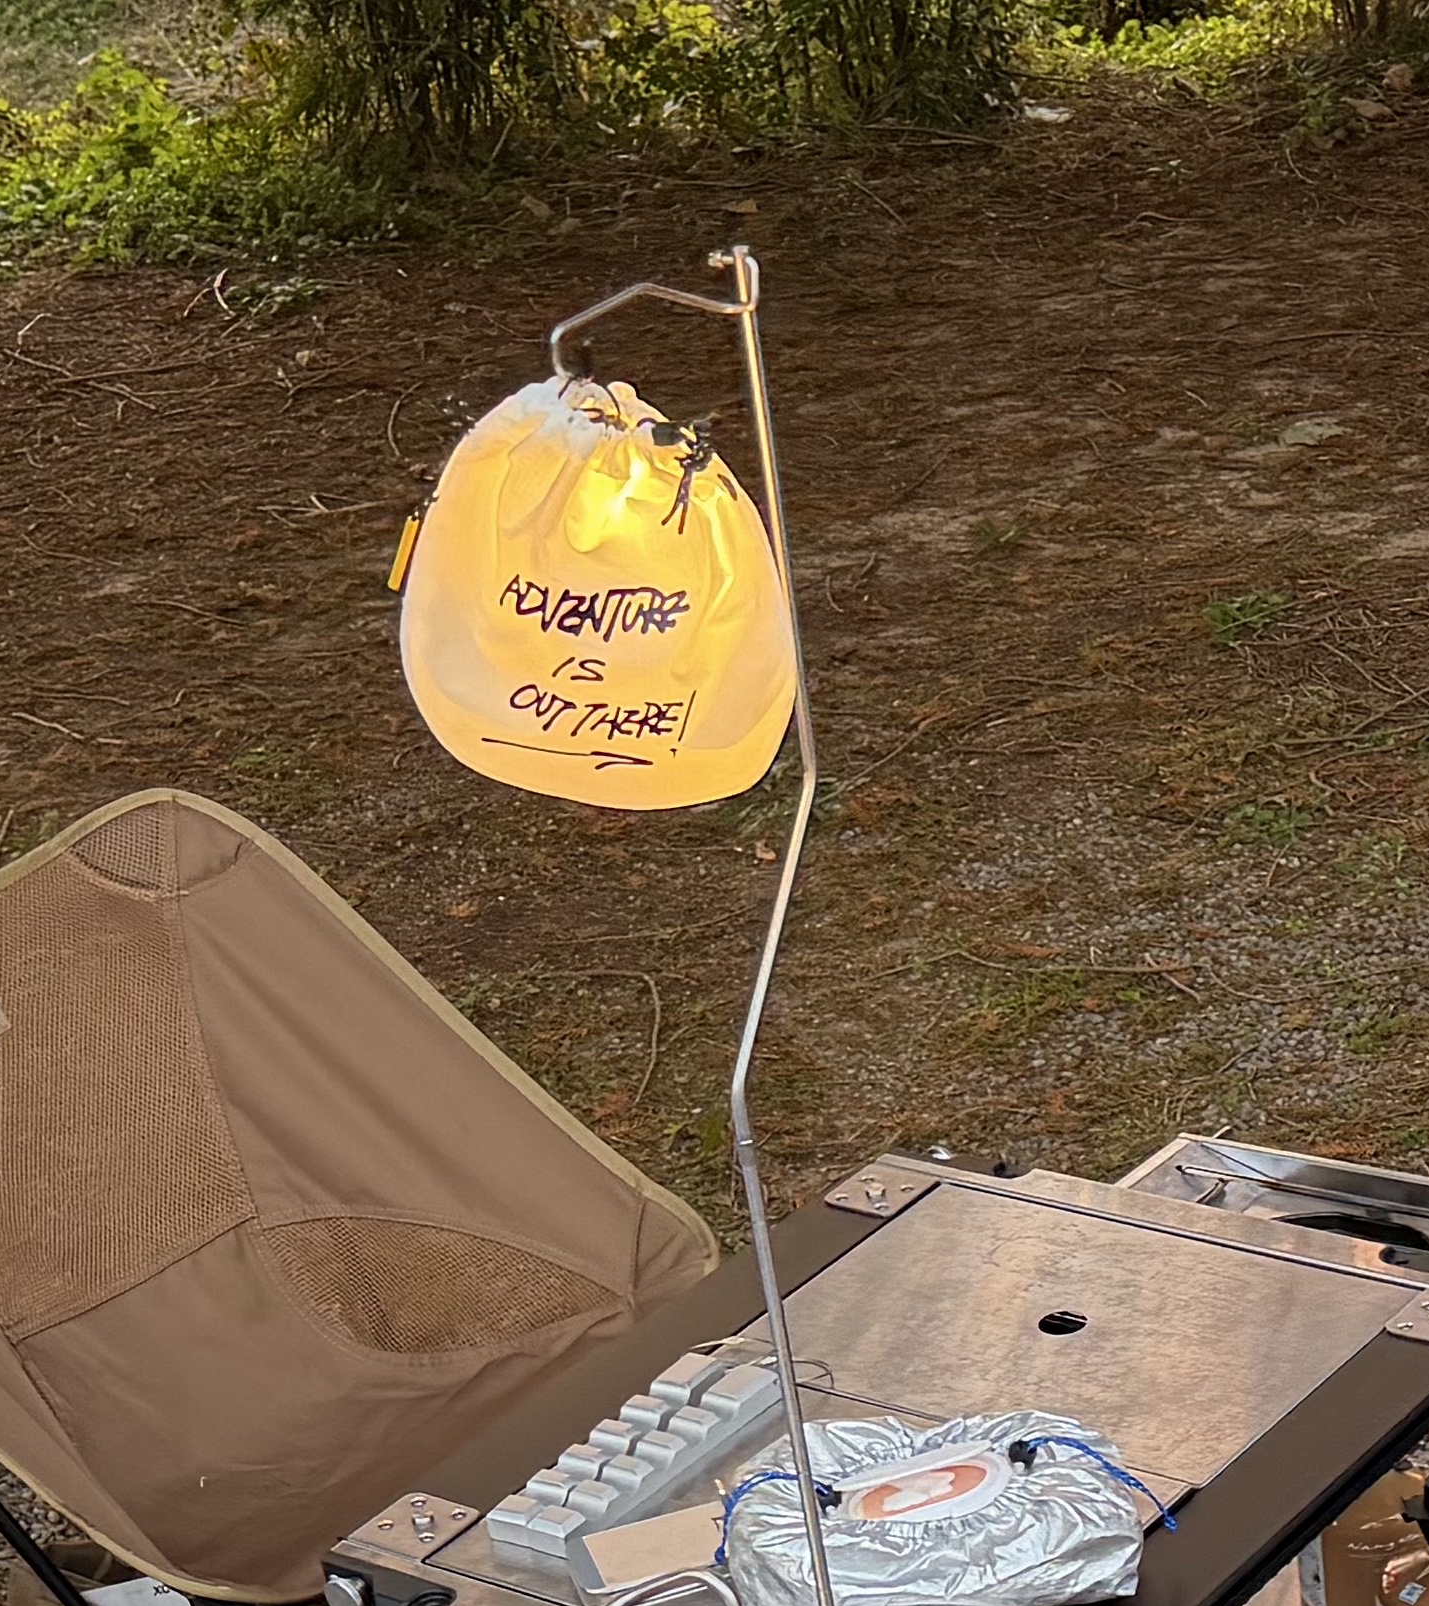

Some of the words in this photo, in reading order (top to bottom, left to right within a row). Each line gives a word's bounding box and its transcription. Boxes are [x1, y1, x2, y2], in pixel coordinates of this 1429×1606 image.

[500, 574, 690, 642] ADVENTURE
[552, 656, 607, 682] IS
[510, 684, 577, 731] OUT
[570, 690, 697, 757] THERE!
